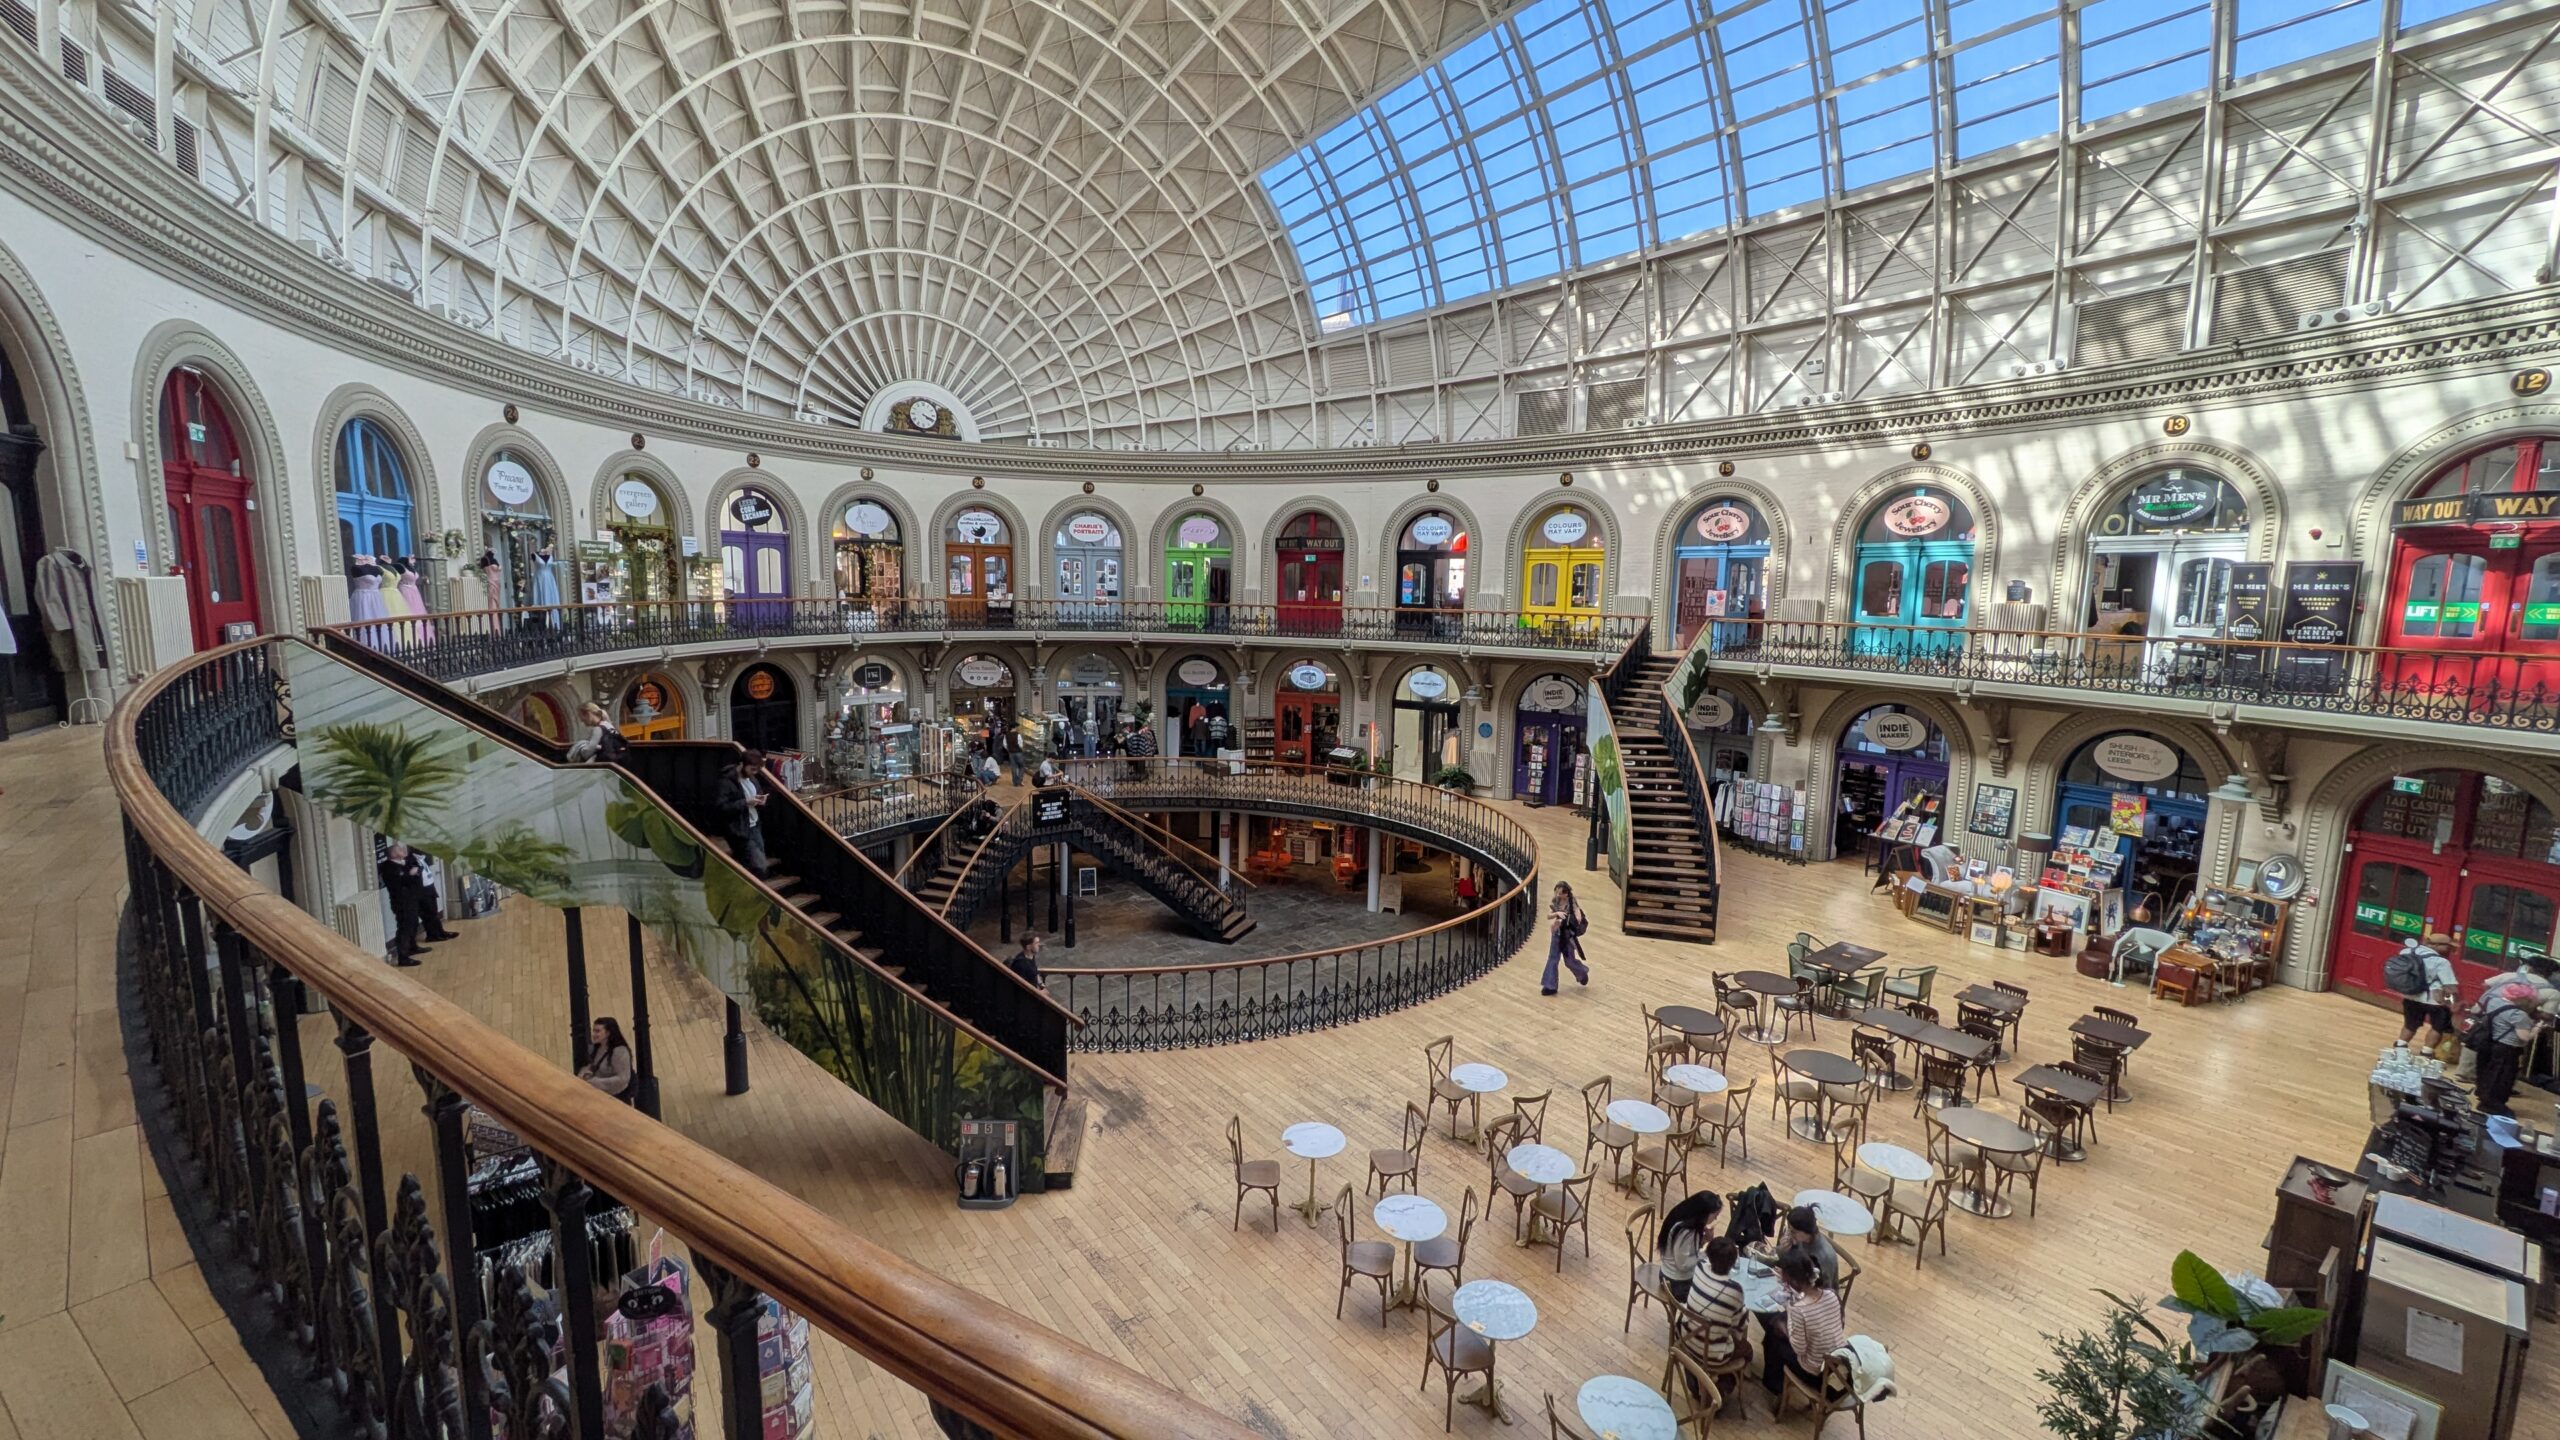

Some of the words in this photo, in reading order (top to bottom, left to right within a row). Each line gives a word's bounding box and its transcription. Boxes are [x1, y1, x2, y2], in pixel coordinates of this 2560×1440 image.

[2515, 373, 2545, 390] 12
[2167, 418, 2185, 431] 13
[1914, 447, 1928, 456] 14
[749, 456, 759, 465] 22
[862, 469, 873, 478] 21
[1720, 464, 1732, 473] 15
[619, 489, 652, 500] evergreen
[2137, 494, 2161, 505] MR
[2162, 491, 2207, 503] MEN'S
[625, 500, 648, 510] gallery
[739, 498, 757, 508] LEEDS
[1891, 499, 1913, 516] Sour
[1913, 498, 1943, 515] Cherry
[2495, 496, 2558, 515] WAY
[740, 506, 756, 514] CORN
[742, 509, 770, 520] EXCHANGE
[2403, 504, 2432, 522] WAY
[2433, 500, 2463, 518] OUT
[1702, 509, 1720, 523] Sour
[1721, 508, 1744, 524] Cherry
[1894, 518, 1938, 534] Jewellery
[1705, 526, 1739, 539] Jewellery
[1306, 539, 1323, 548] WAY
[1324, 539, 1339, 548] OUT
[2407, 605, 2439, 617] LIFT
[2229, 626, 2262, 635] WINNING
[2286, 629, 2344, 637] WINNING
[1697, 704, 1718, 712] INDIE
[1879, 723, 1909, 732] INDIE
[2109, 742, 2137, 752] SHUSH
[2108, 749, 2150, 761] INTERIORS
[2357, 905, 2387, 922] LIFT
